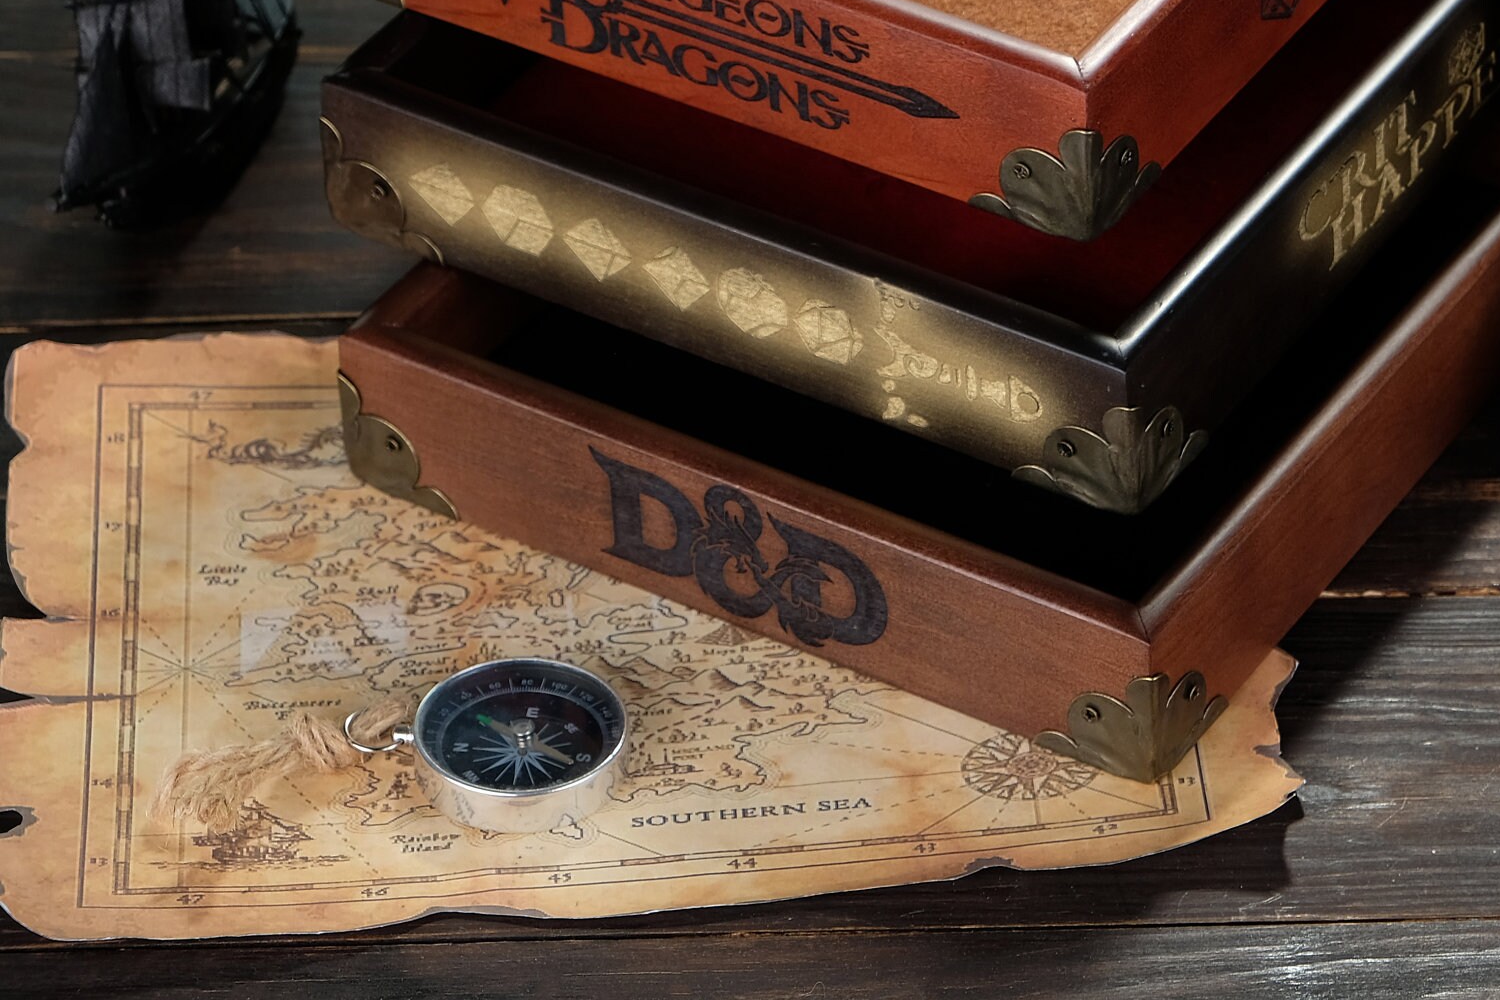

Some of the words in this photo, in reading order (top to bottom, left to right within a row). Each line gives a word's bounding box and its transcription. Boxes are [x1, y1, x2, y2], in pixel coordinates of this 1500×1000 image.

[1299, 89, 1416, 241] CRIT
[588, 443, 889, 647] D&D
[526, 707, 540, 718] E
[576, 753, 591, 763] S
[631, 801, 806, 829] SOUTHERN
[818, 796, 873, 812] SEA
[726, 857, 758, 871] 44
[548, 872, 571, 884] 45
